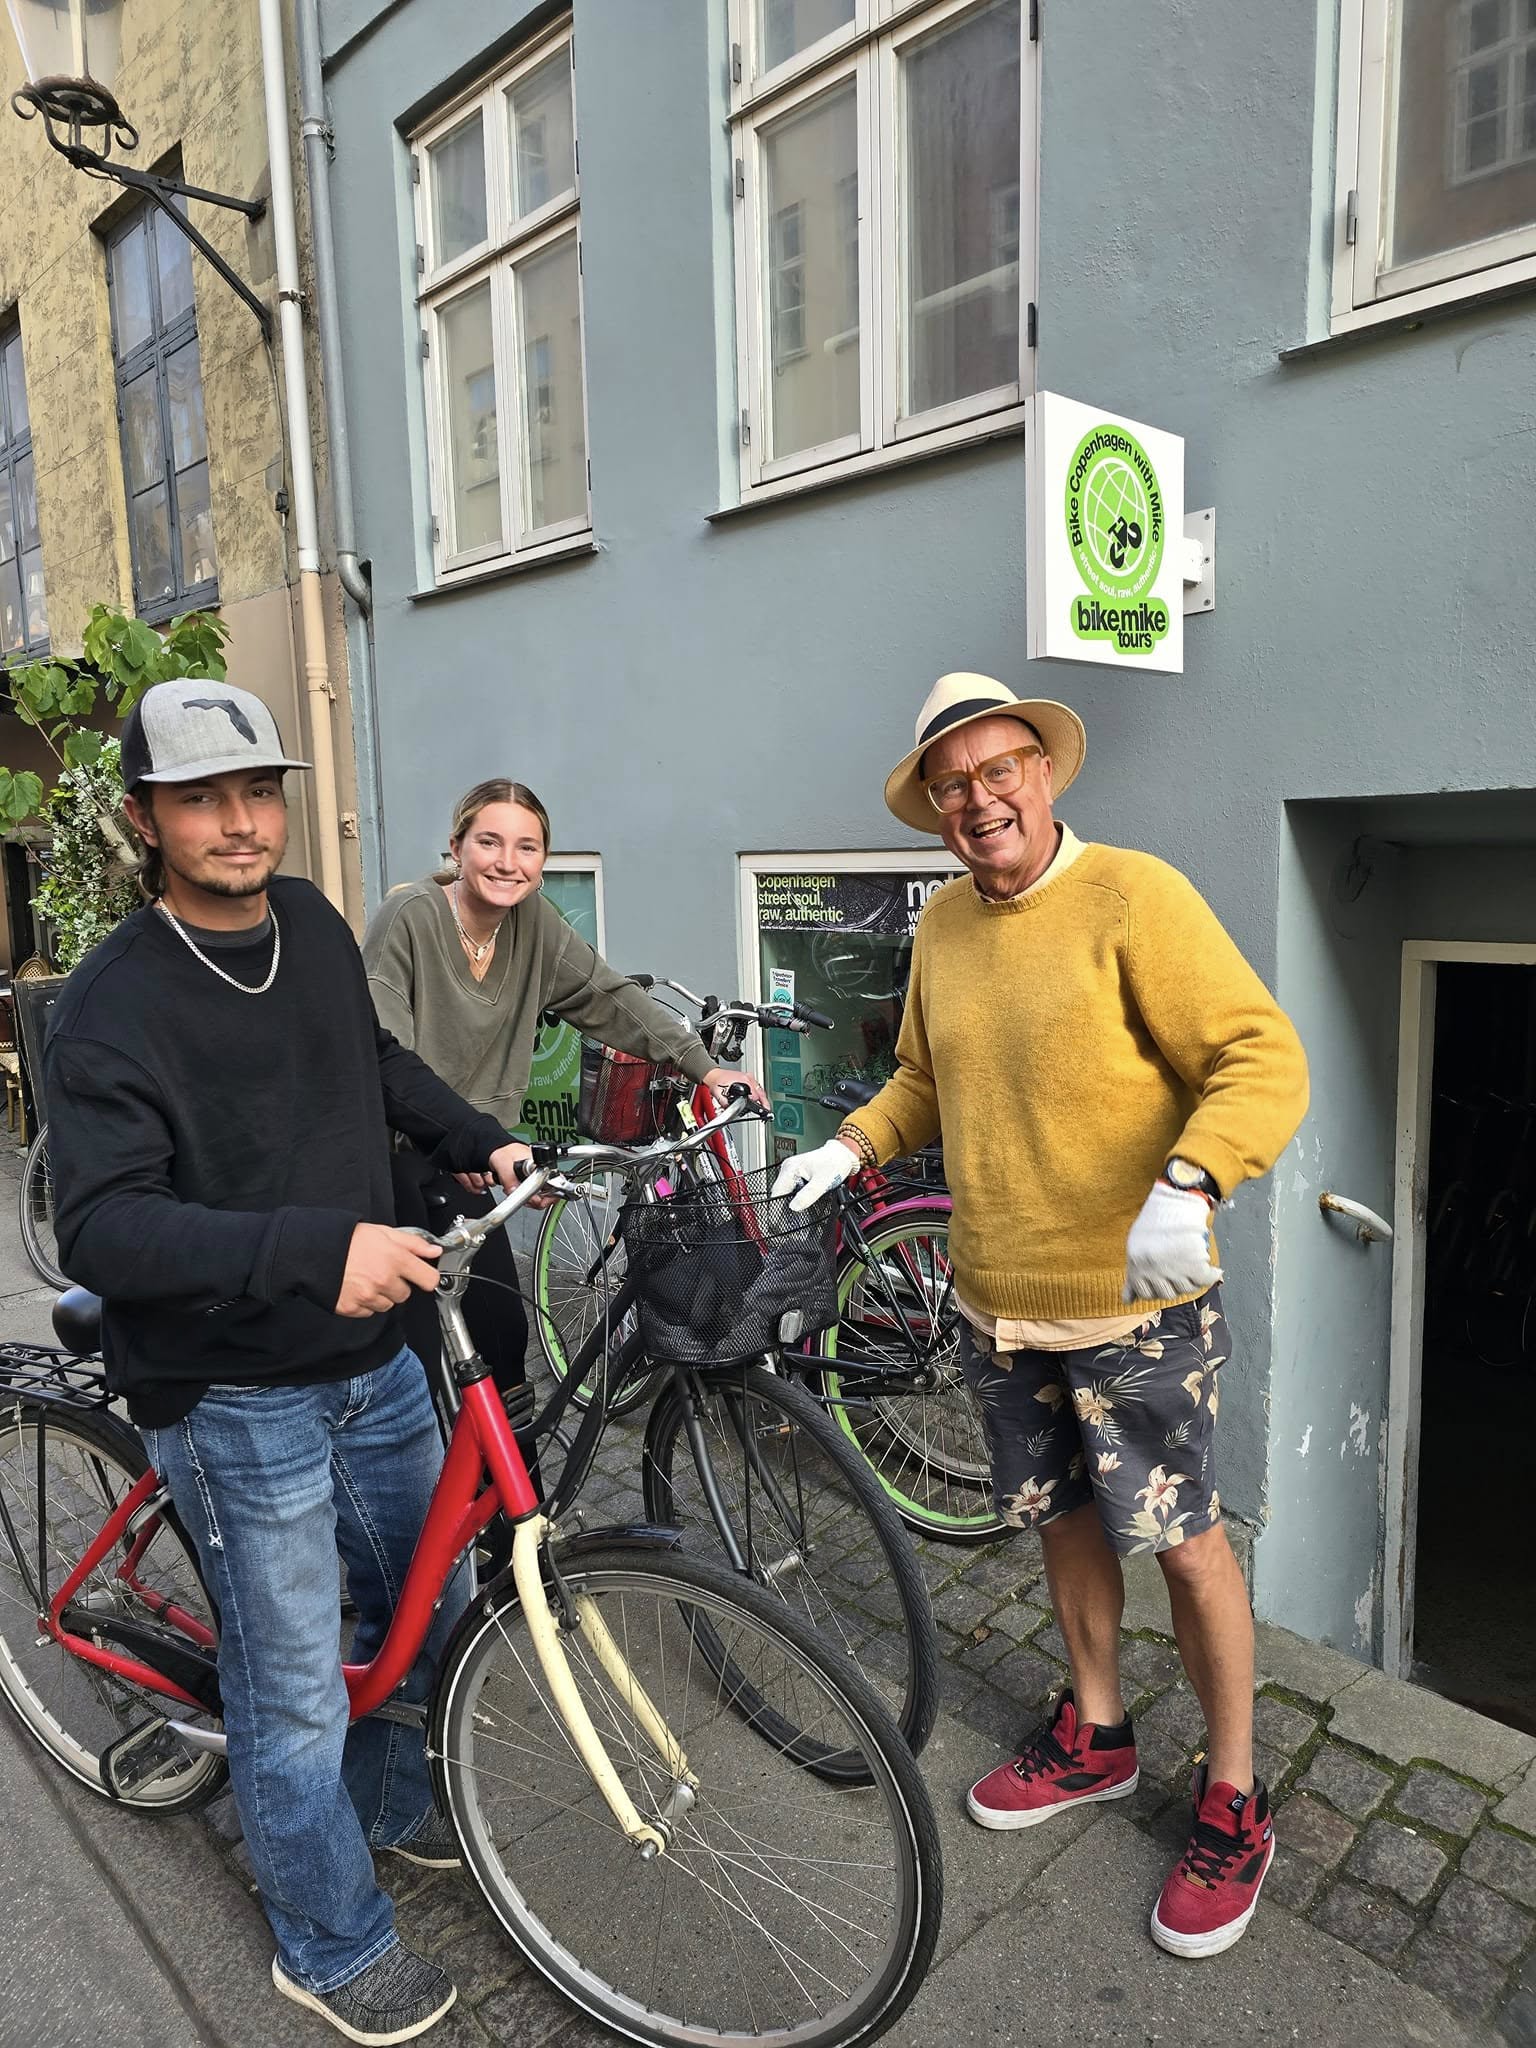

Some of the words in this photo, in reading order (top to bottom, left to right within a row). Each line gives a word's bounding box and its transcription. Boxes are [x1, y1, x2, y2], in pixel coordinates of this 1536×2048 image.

[1070, 432, 1132, 493] Copenhagen
[1133, 450, 1154, 491] with
[1069, 497, 1083, 547] Bike
[1149, 491, 1162, 543] Mike
[1117, 628, 1153, 648] tours
[757, 874, 836, 892] Copenhagen
[758, 890, 793, 906] street
[794, 890, 824, 908] soul,
[759, 908, 783, 923] raw,
[785, 906, 844, 923] authentic
[533, 1075, 553, 1088] raw,
[775, 1140, 795, 1151] 2020
